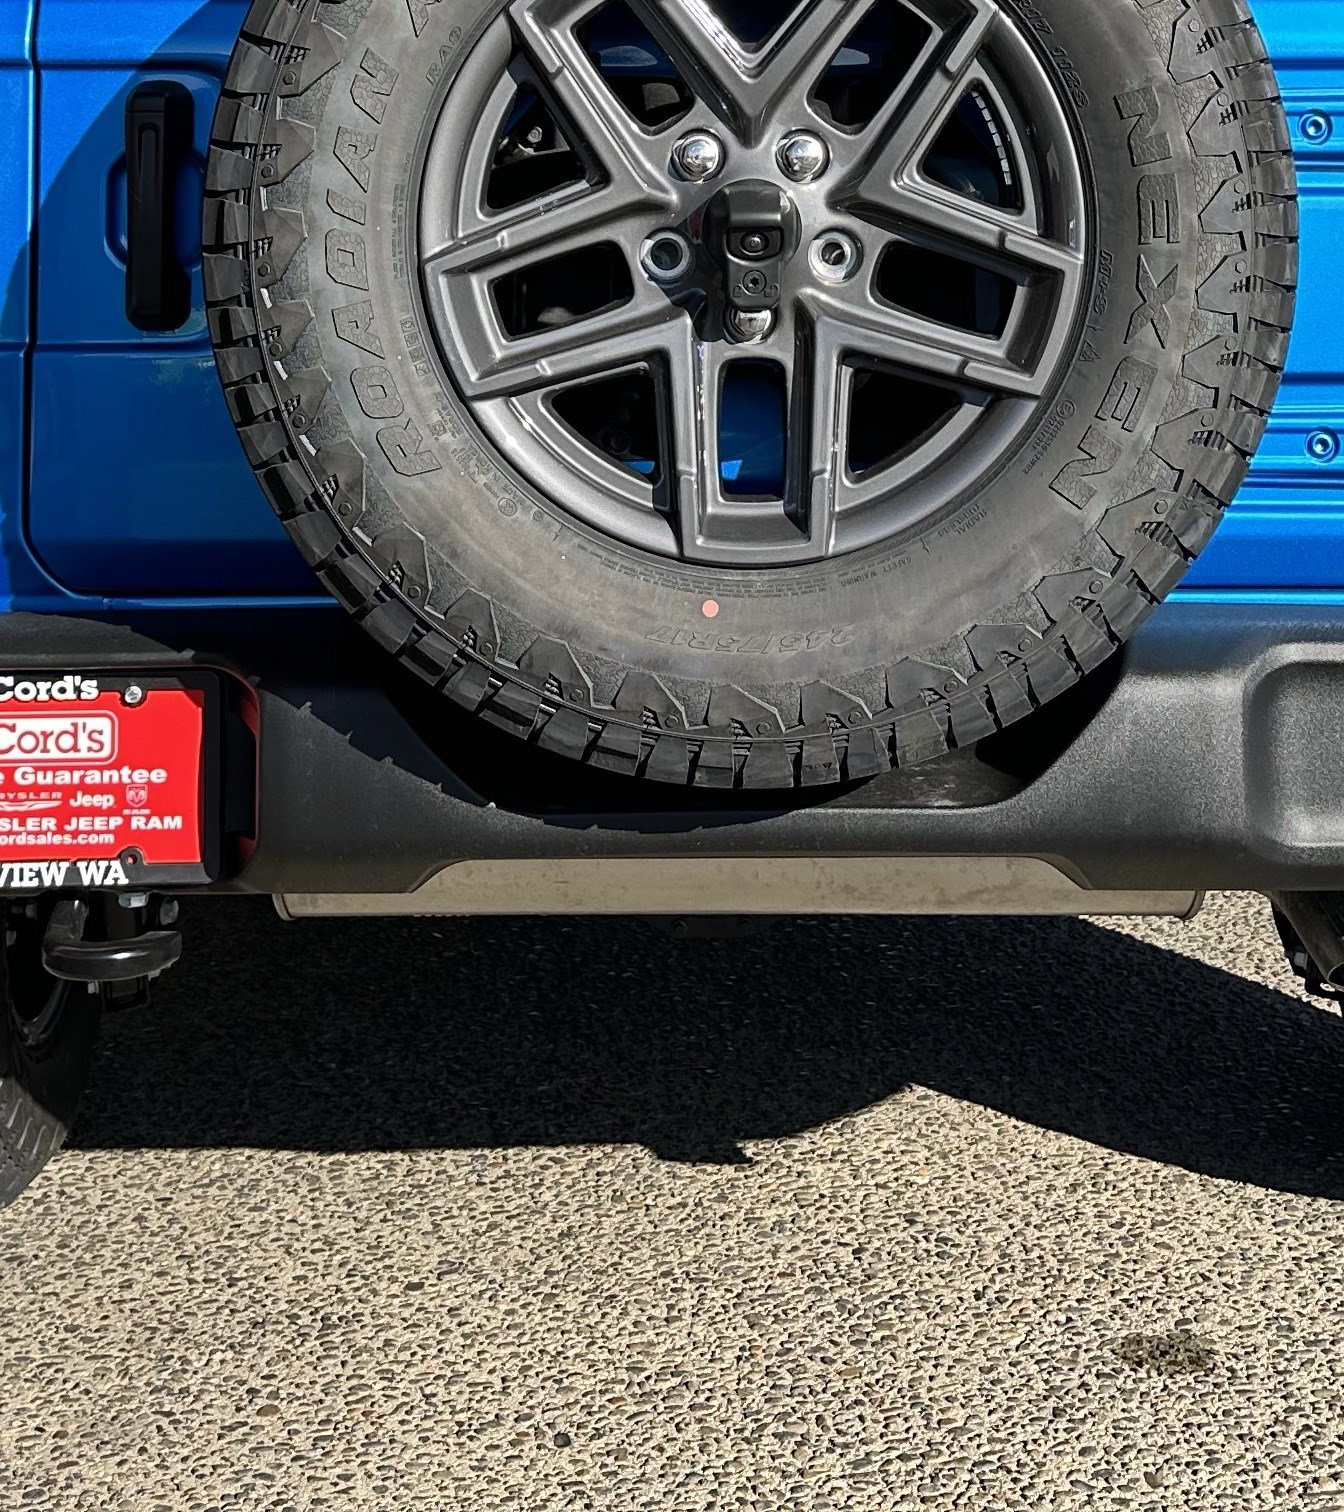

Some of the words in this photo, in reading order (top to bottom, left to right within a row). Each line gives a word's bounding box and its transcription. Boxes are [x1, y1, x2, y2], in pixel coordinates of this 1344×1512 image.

[325, 47, 442, 478] ROADIAN
[1049, 85, 1181, 510] NEXEN
[14, 764, 168, 786] Guarantee
[69, 790, 116, 810] Jeep
[63, 815, 124, 832] JEEP
[130, 815, 183, 830] RAM
[76, 859, 129, 886] WA
